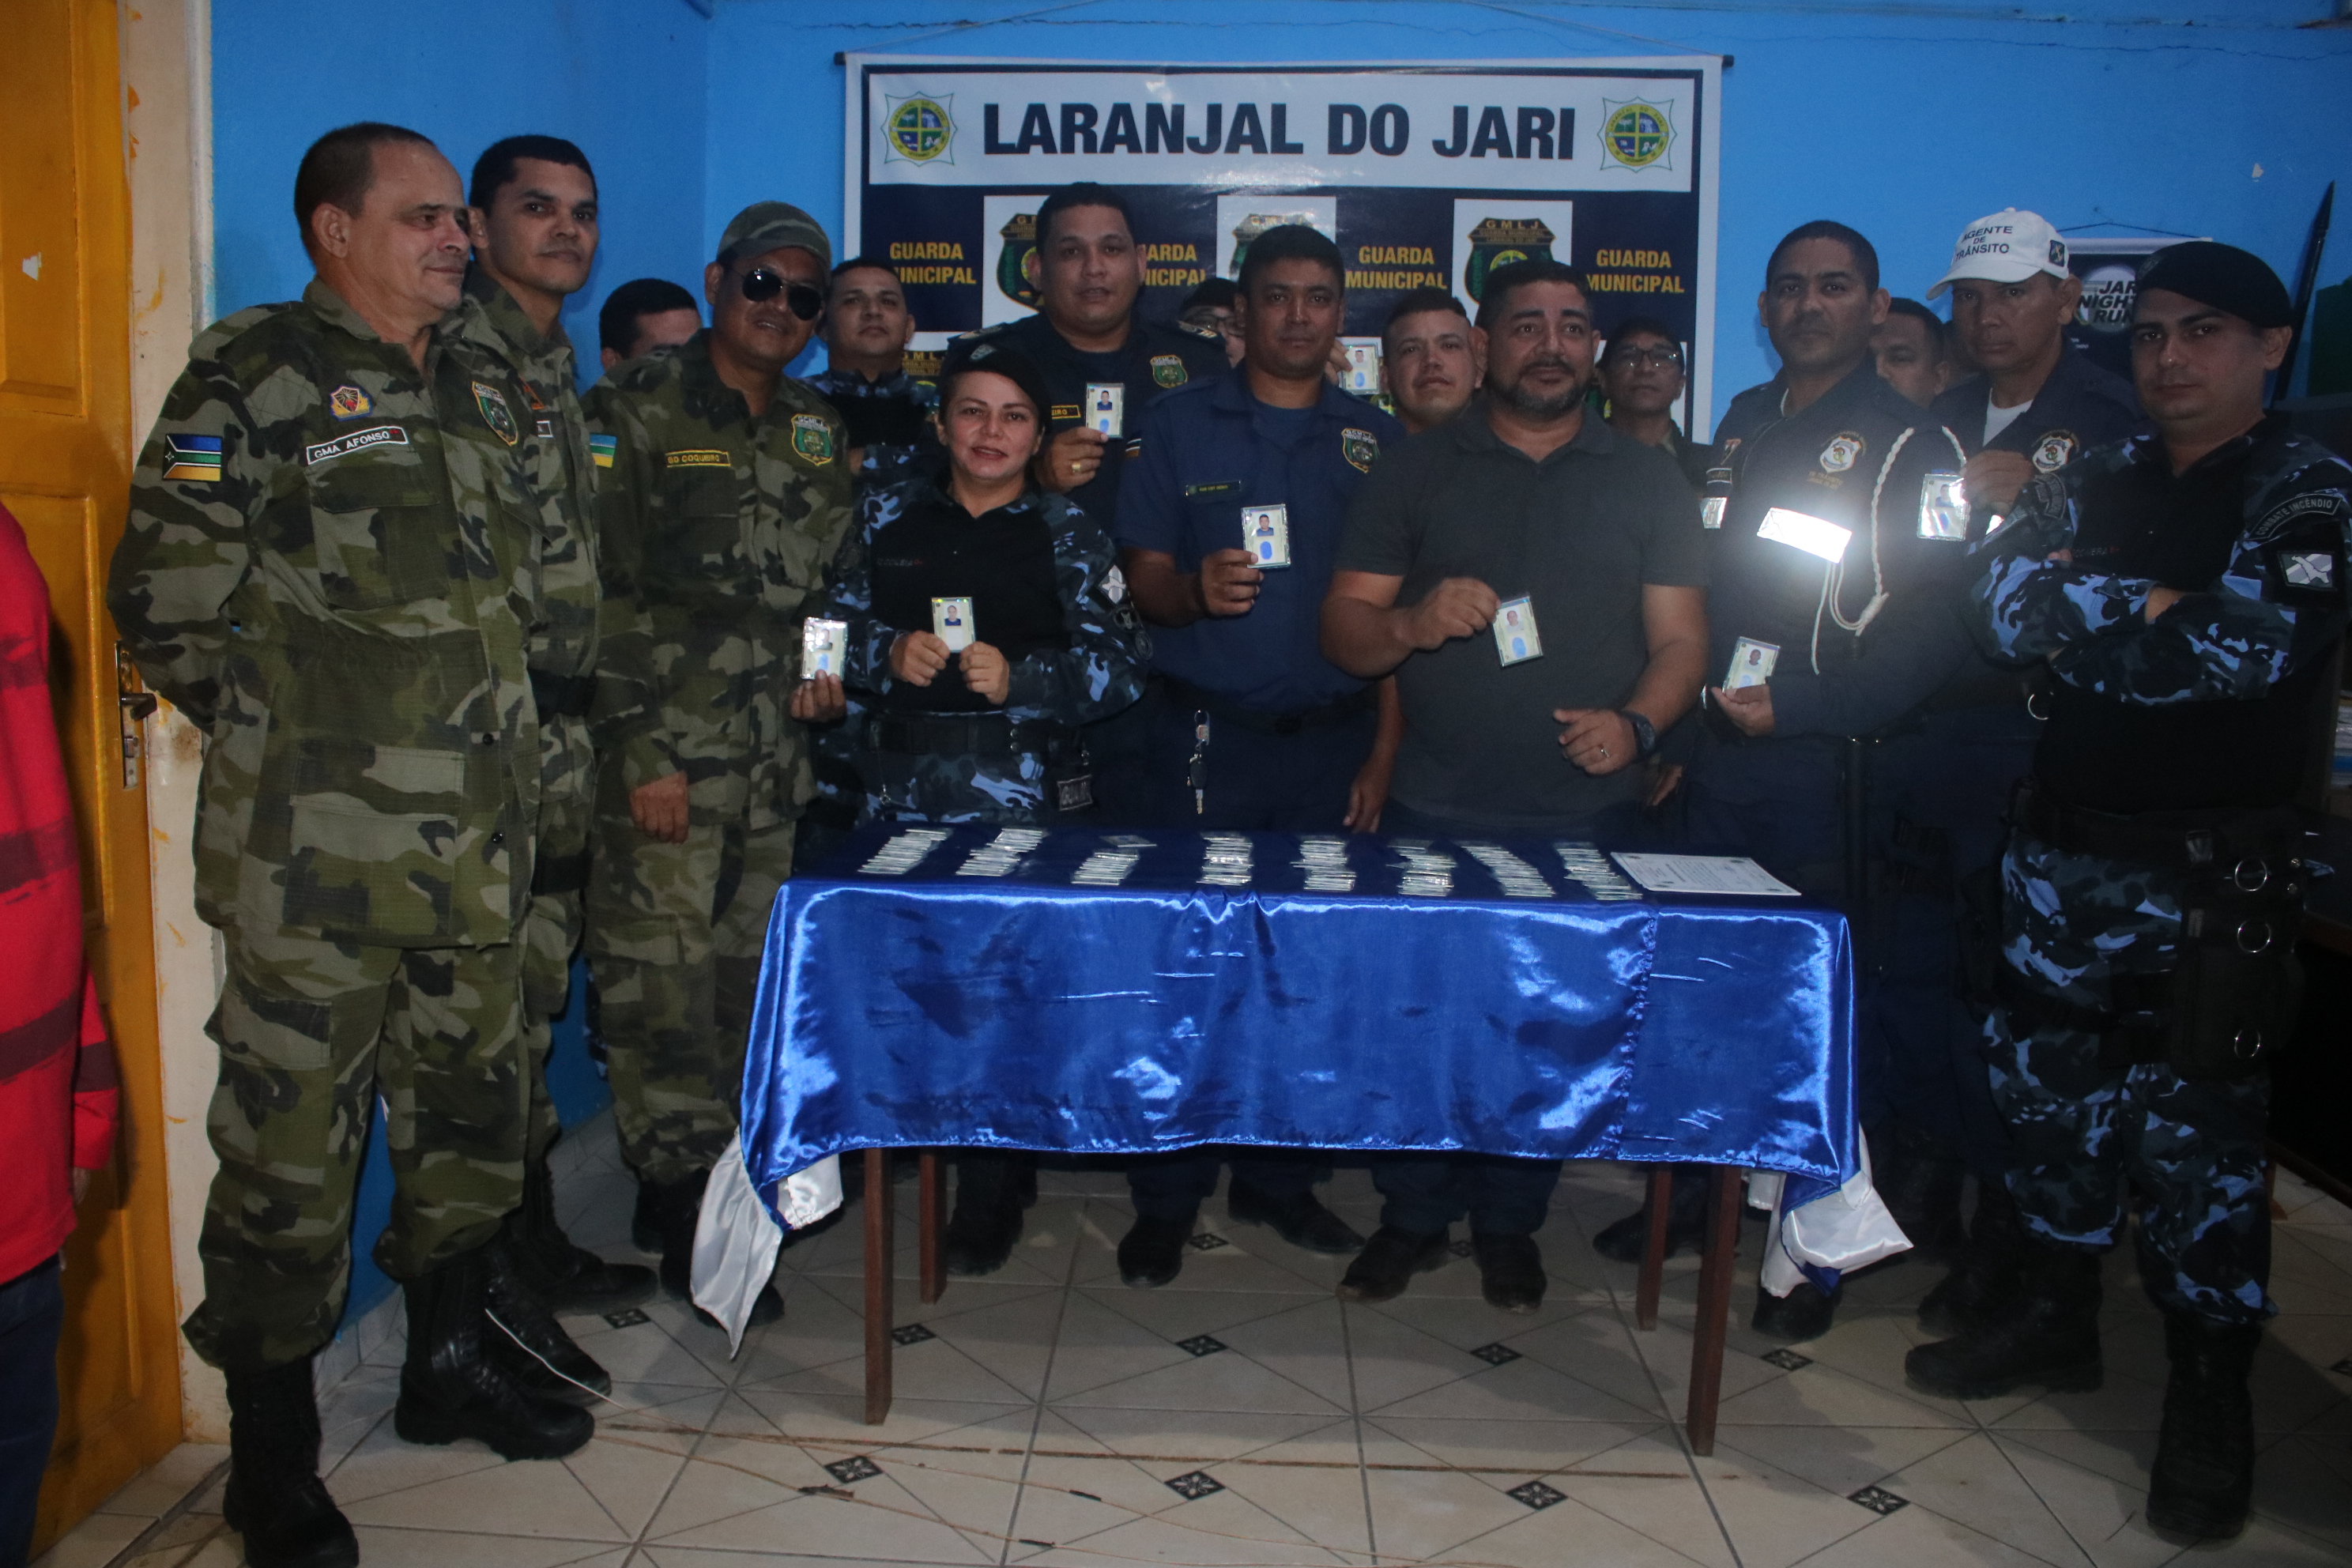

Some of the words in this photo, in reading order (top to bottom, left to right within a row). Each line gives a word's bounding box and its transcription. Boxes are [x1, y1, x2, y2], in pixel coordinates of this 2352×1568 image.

[984, 103, 1304, 155] LARANJAL
[1328, 104, 1410, 156] DO
[1432, 105, 1576, 160] JARI
[1962, 225, 2014, 243] AGENTE
[1973, 236, 1986, 245] DE
[889, 241, 964, 260] GUARDA
[1147, 243, 1197, 262] ARDA
[1359, 245, 1435, 265] GUARDA
[1596, 249, 1672, 268] GUARDA
[894, 266, 977, 285] UNICIPAL
[1344, 270, 1448, 289] MUNICIPAL
[1585, 273, 1685, 293] MUNICIPAL
[2098, 281, 2137, 295] JAR
[2077, 296, 2137, 309] NIGH
[314, 444, 341, 459] GMA
[345, 430, 390, 450] AFONSO
[2255, 507, 2290, 536] COMBATE
[2288, 497, 2333, 513] INCÊNDIO
